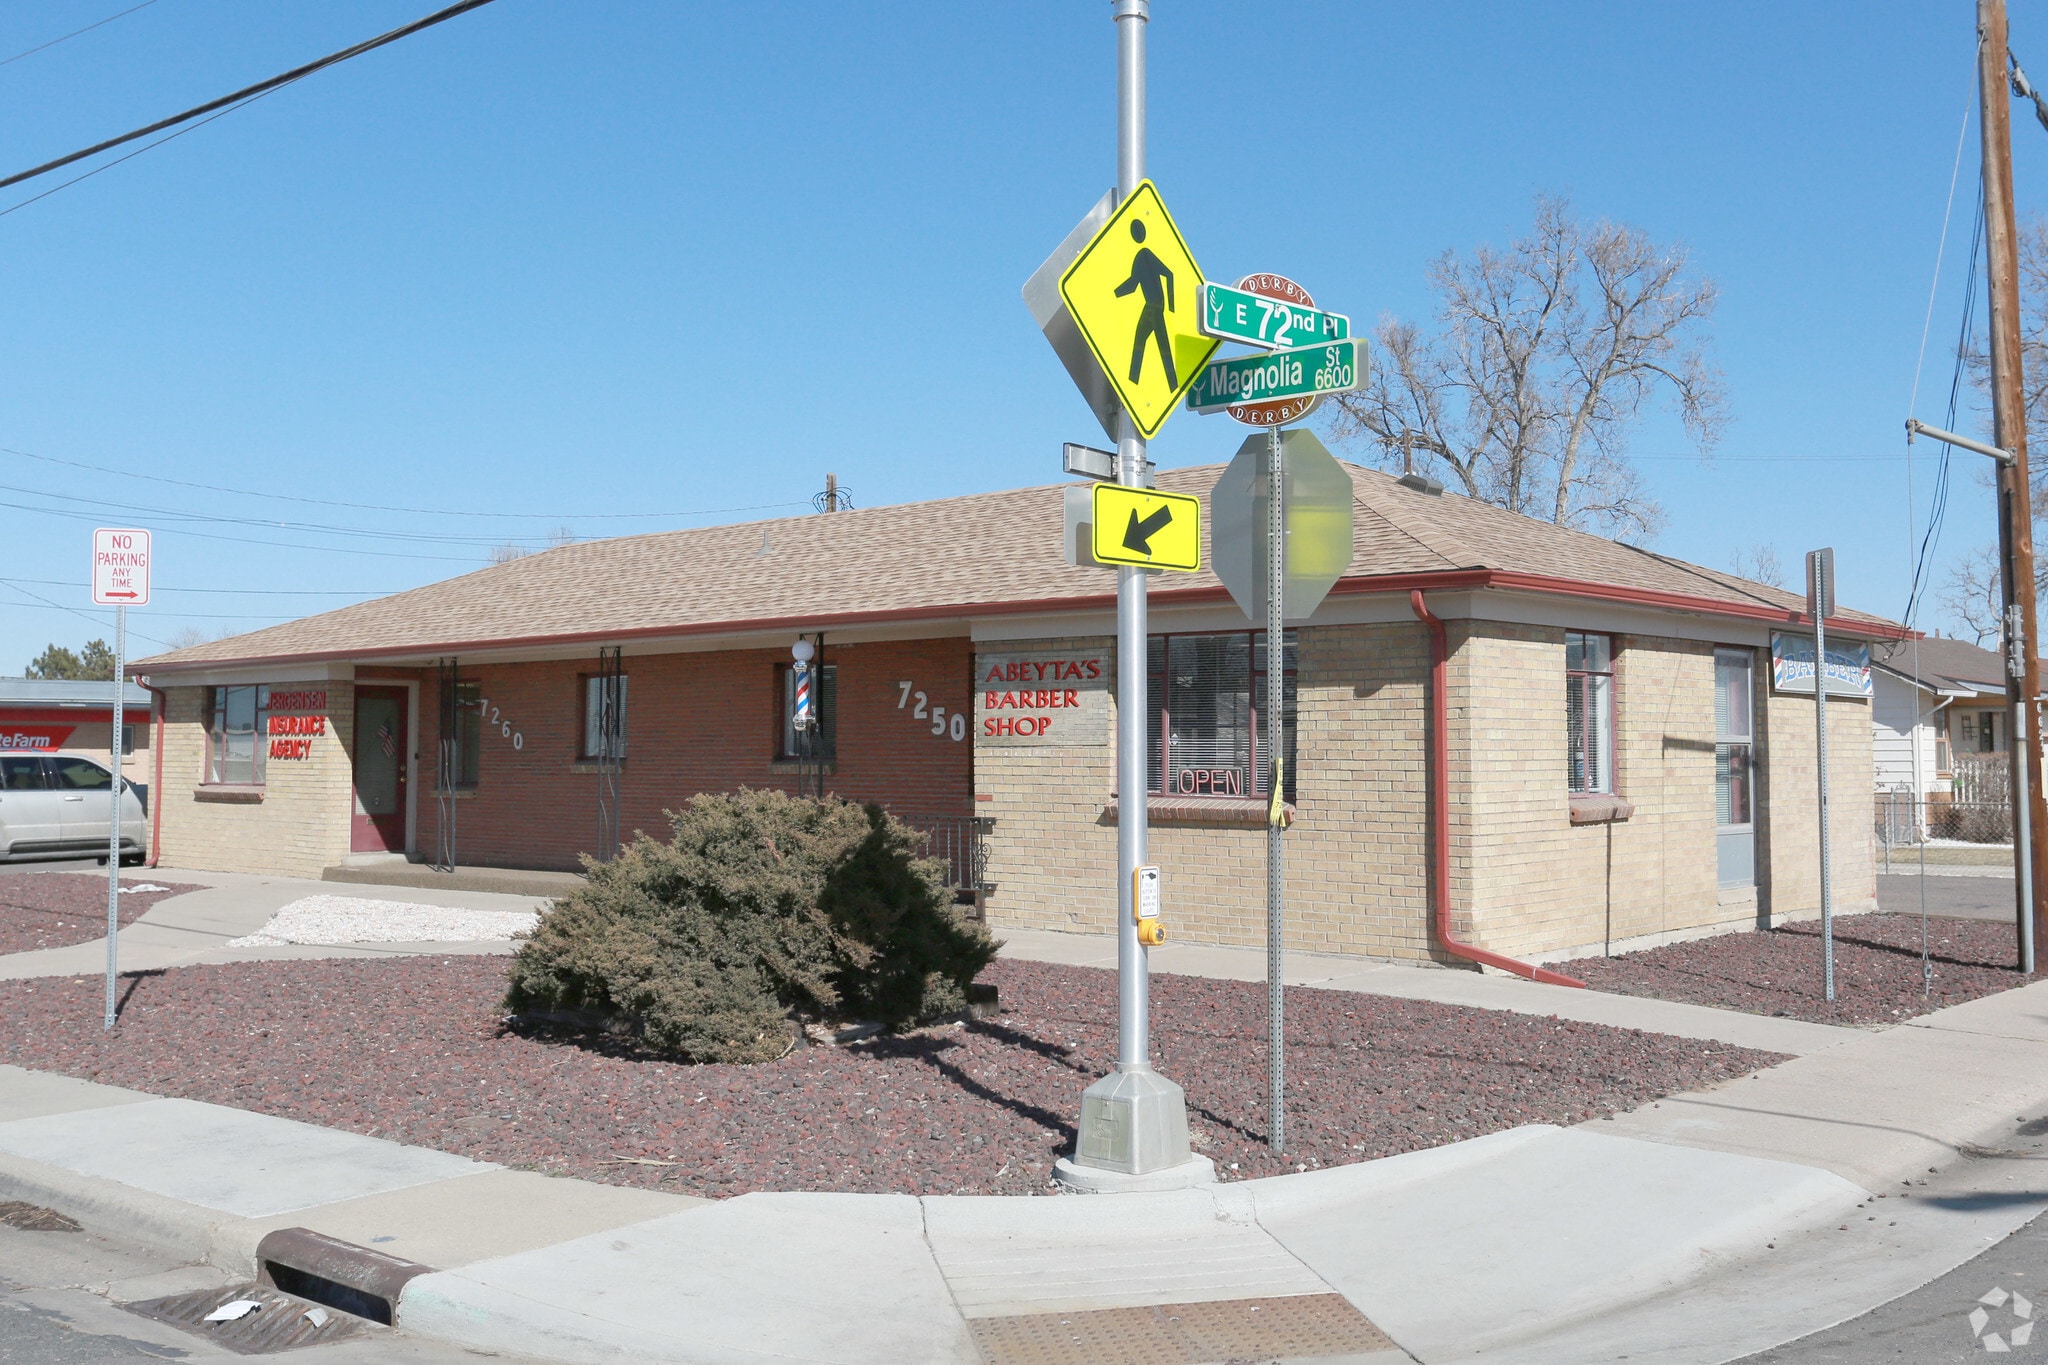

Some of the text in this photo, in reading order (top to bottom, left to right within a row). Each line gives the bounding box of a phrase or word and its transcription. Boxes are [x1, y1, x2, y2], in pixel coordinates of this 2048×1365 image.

[1248, 275, 1307, 303] DERBY
[1236, 299, 1338, 346] E 72nd Pl
[1210, 346, 1341, 400] Magnolia St
[1314, 364, 1351, 389] 6600
[1236, 398, 1305, 423] DERBY
[112, 535, 132, 549] NO
[98, 552, 146, 567] PARKING
[111, 578, 132, 588] TIME
[112, 567, 131, 577] ANY
[985, 659, 1101, 682] ABEYTA'S
[985, 689, 1080, 709] BARBER
[898, 681, 966, 742] 7250
[268, 715, 327, 737] INSURANCE
[480, 699, 523, 750] 7260
[983, 716, 1052, 736] SHOP
[269, 739, 313, 760] AGENCY
[1179, 769, 1241, 795] OPEN
